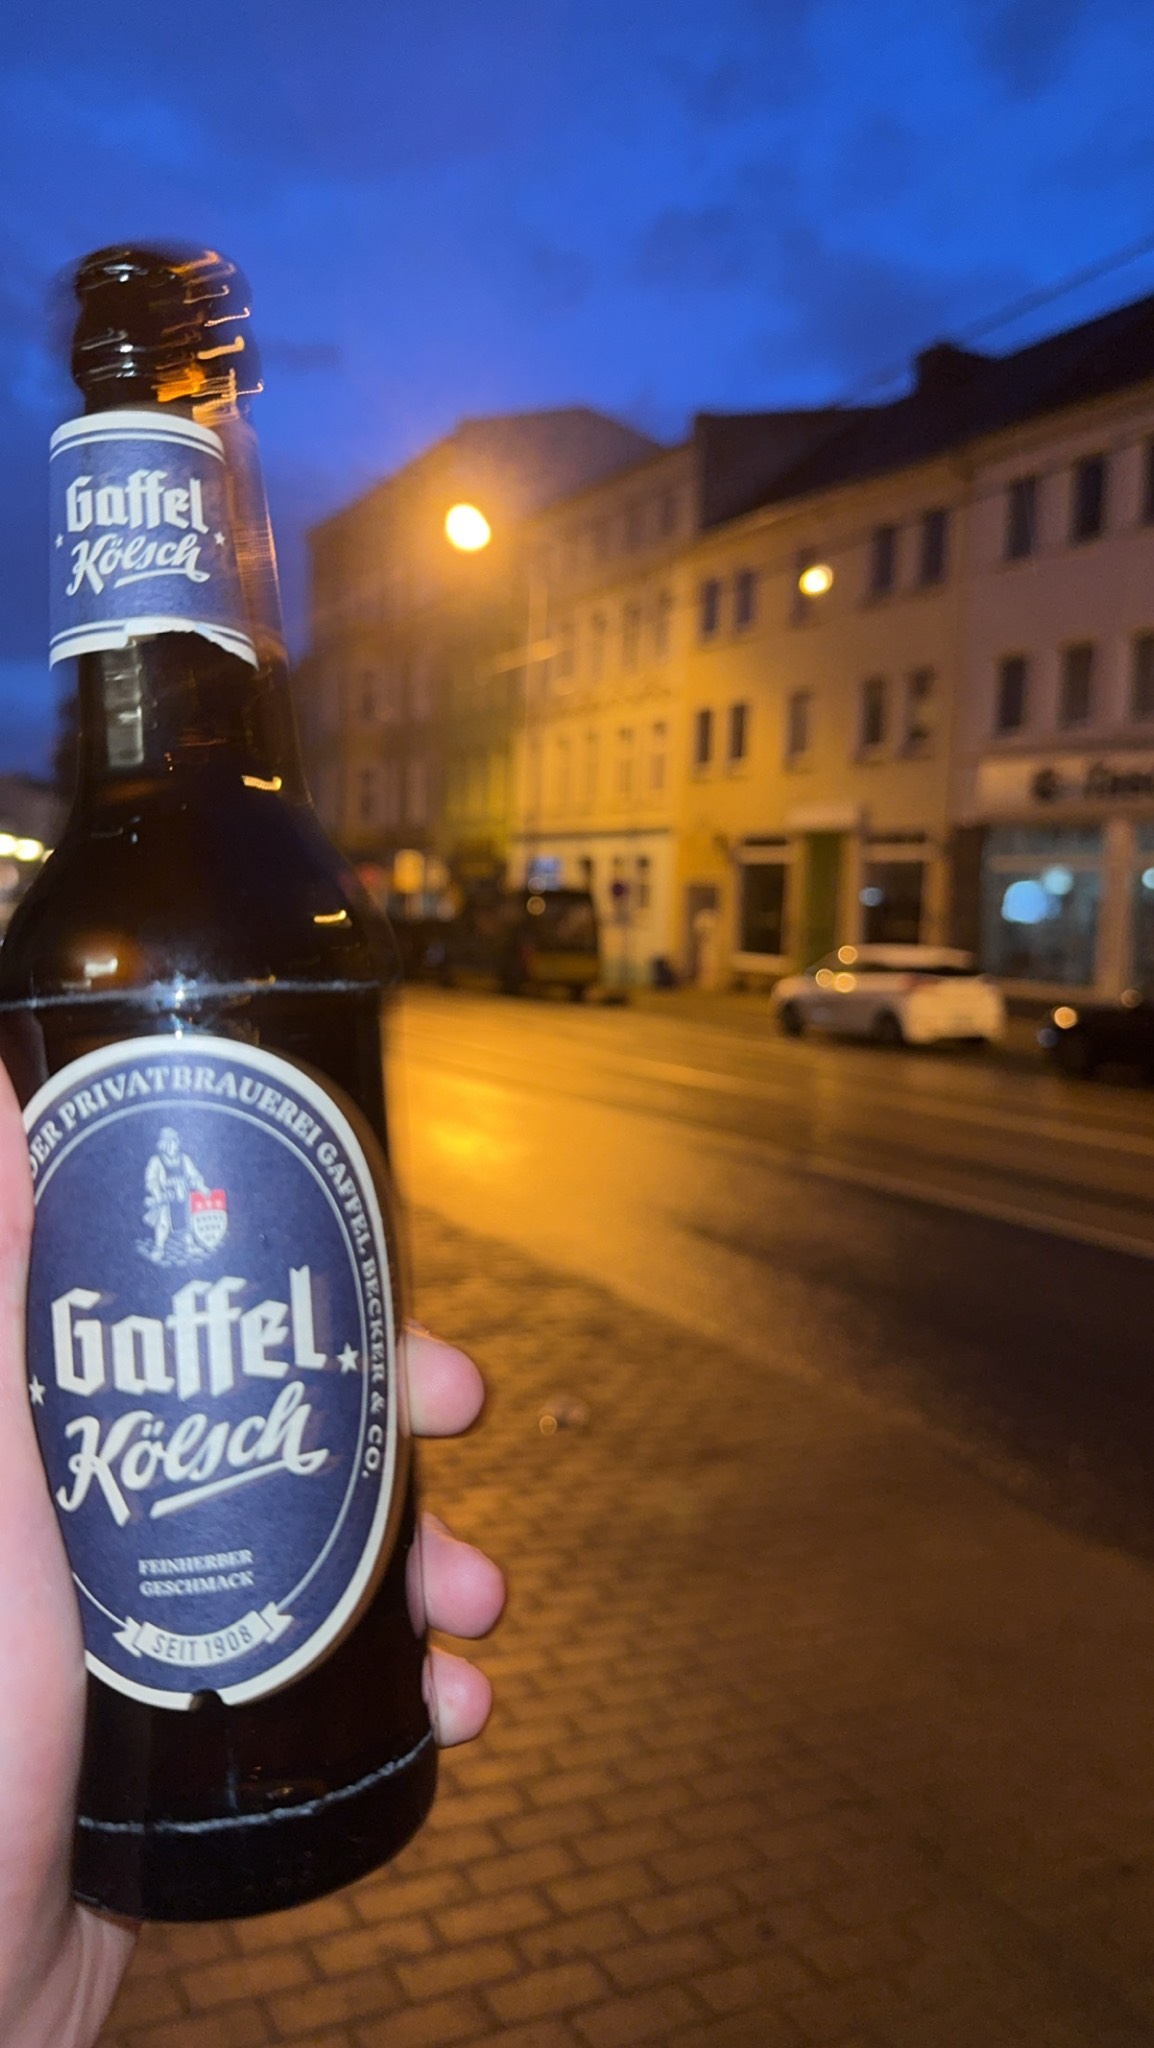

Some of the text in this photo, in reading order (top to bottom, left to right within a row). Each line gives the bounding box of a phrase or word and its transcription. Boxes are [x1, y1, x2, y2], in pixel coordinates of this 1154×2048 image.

[66, 468, 210, 534] Gaffel
[65, 532, 211, 596] Kölsch
[58, 1066, 323, 1148] PRIVATBRAUEREI
[316, 1141, 371, 1256] GAFFEL
[51, 1264, 327, 1401] Gaffel
[361, 1255, 386, 1383] BECKER
[370, 1389, 385, 1415] &
[55, 1380, 330, 1527] Kölsch
[361, 1424, 384, 1478] CO.
[138, 1549, 254, 1576] FEINHERBER
[139, 1570, 255, 1597] GESCHMACK
[152, 1624, 253, 1661] SEIT 1908
